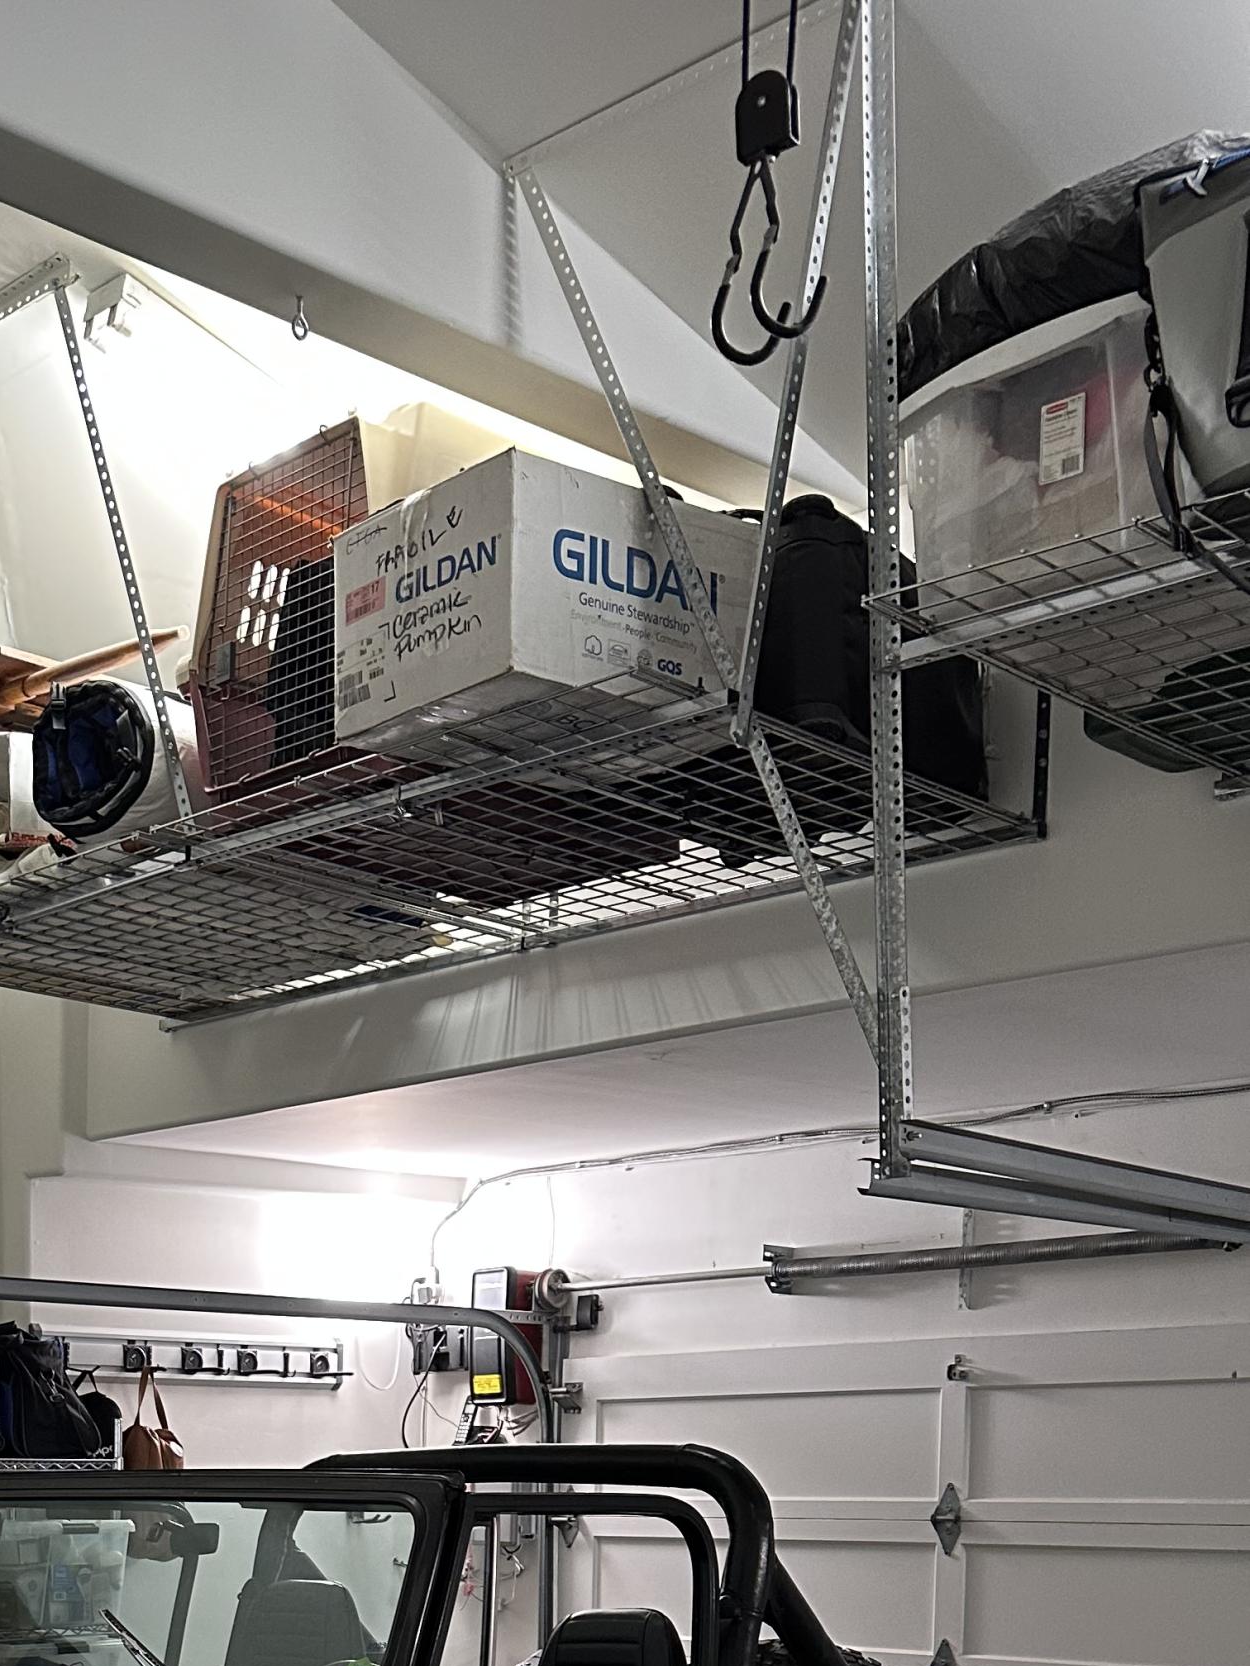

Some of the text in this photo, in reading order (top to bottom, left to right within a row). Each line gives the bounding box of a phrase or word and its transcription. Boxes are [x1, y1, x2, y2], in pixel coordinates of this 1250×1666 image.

[395, 536, 497, 604] GILDAN
[578, 592, 691, 636] Genuine Stewardship
[657, 658, 683, 676] GQS
